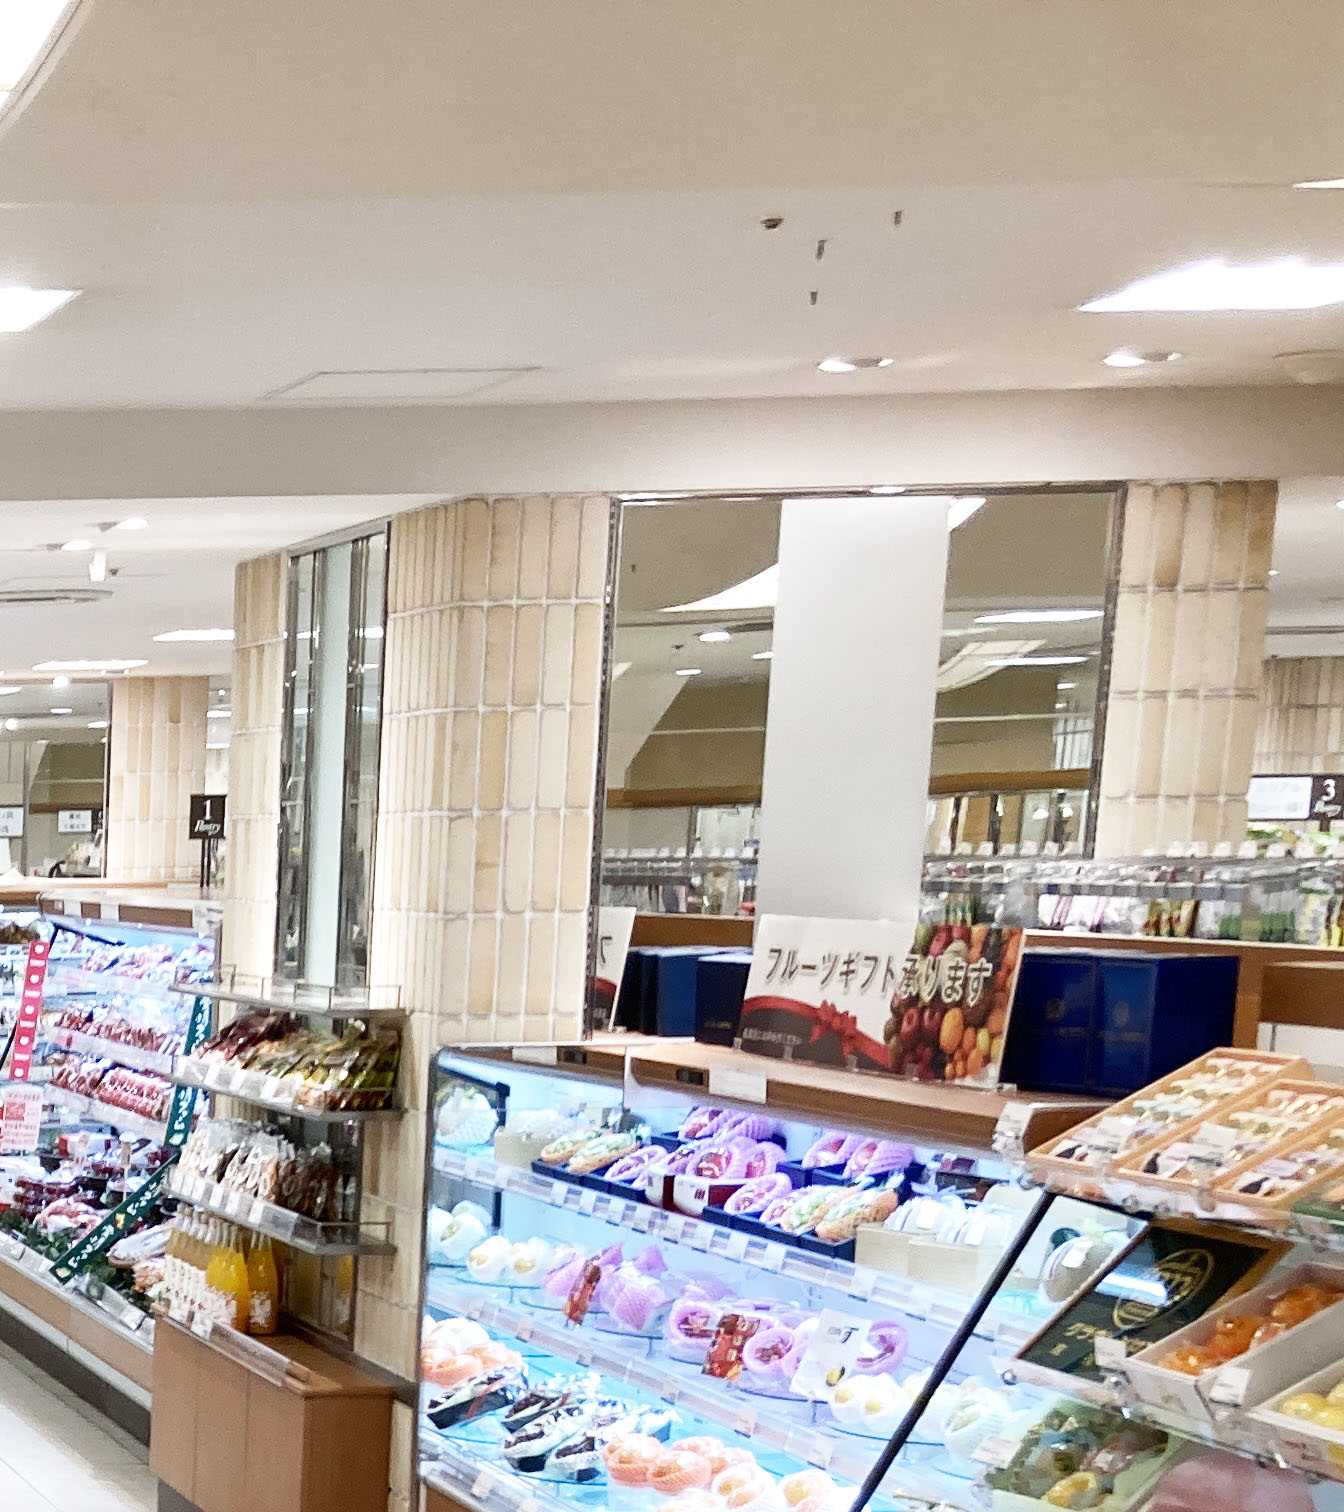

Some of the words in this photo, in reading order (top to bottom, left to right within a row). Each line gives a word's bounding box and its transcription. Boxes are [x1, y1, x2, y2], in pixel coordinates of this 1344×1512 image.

[1323, 778, 1336, 802] 3
[204, 799, 211, 821] 1
[764, 947, 993, 1008] フルーツギフト承ります
